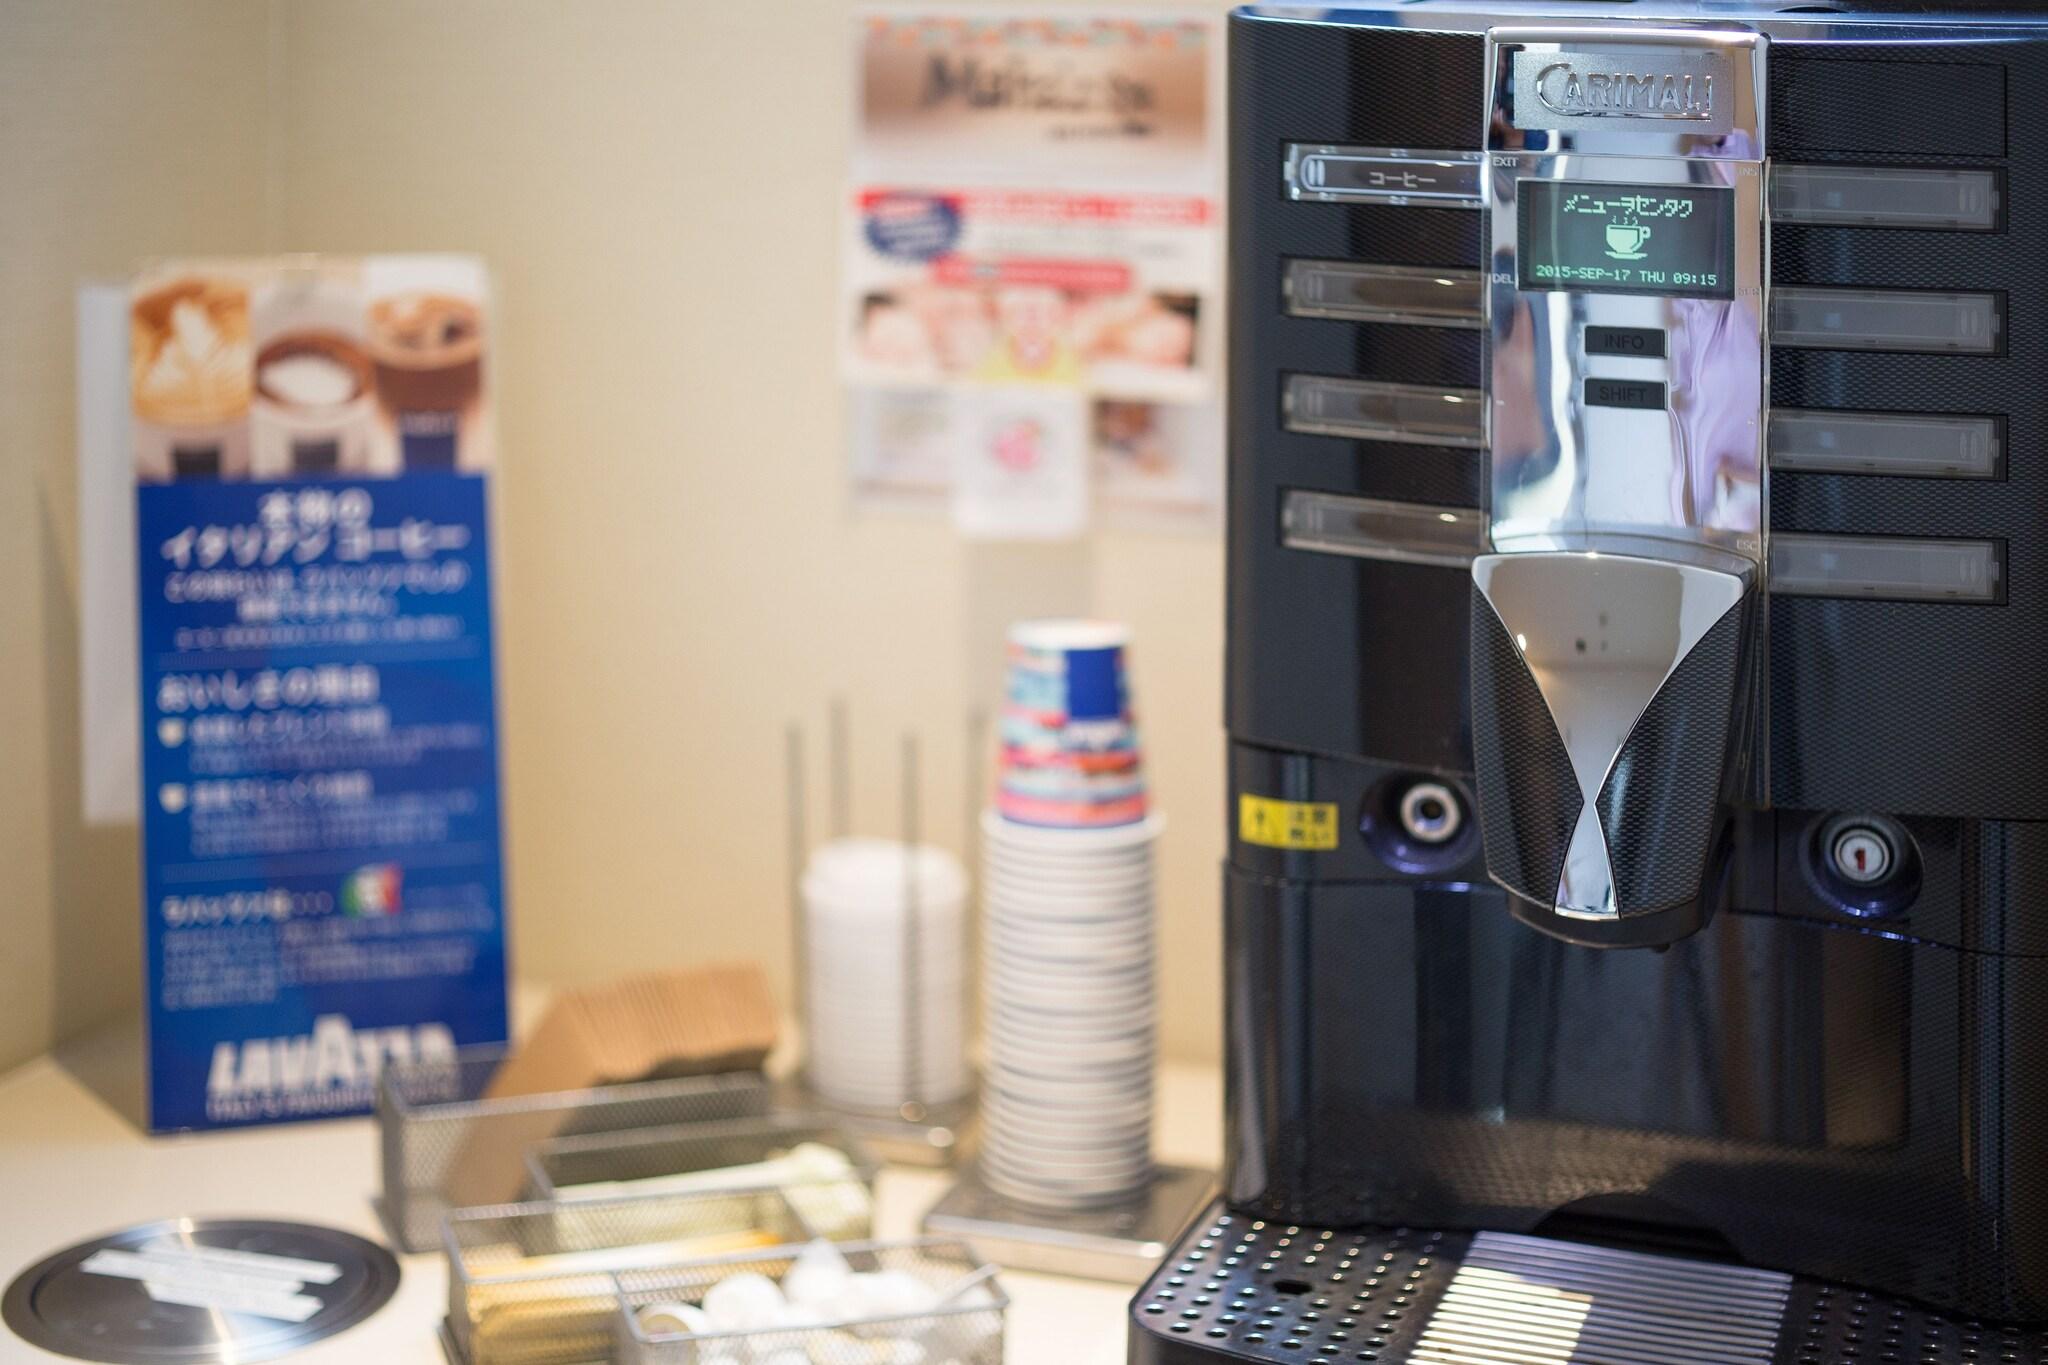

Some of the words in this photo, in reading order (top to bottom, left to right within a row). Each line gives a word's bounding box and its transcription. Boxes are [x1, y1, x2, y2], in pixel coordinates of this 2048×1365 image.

[1537, 63, 1712, 121] CARIMALI
[1492, 156, 1519, 167] EXIT
[1369, 172, 1437, 188] コーヒー
[1492, 272, 1514, 284] DEL
[1535, 264, 1631, 281] 2015-SEP-17
[1639, 270, 1666, 284] THU
[1673, 272, 1717, 285] 09:15
[1603, 333, 1645, 350] INFO
[1599, 386, 1648, 402] SHIFT
